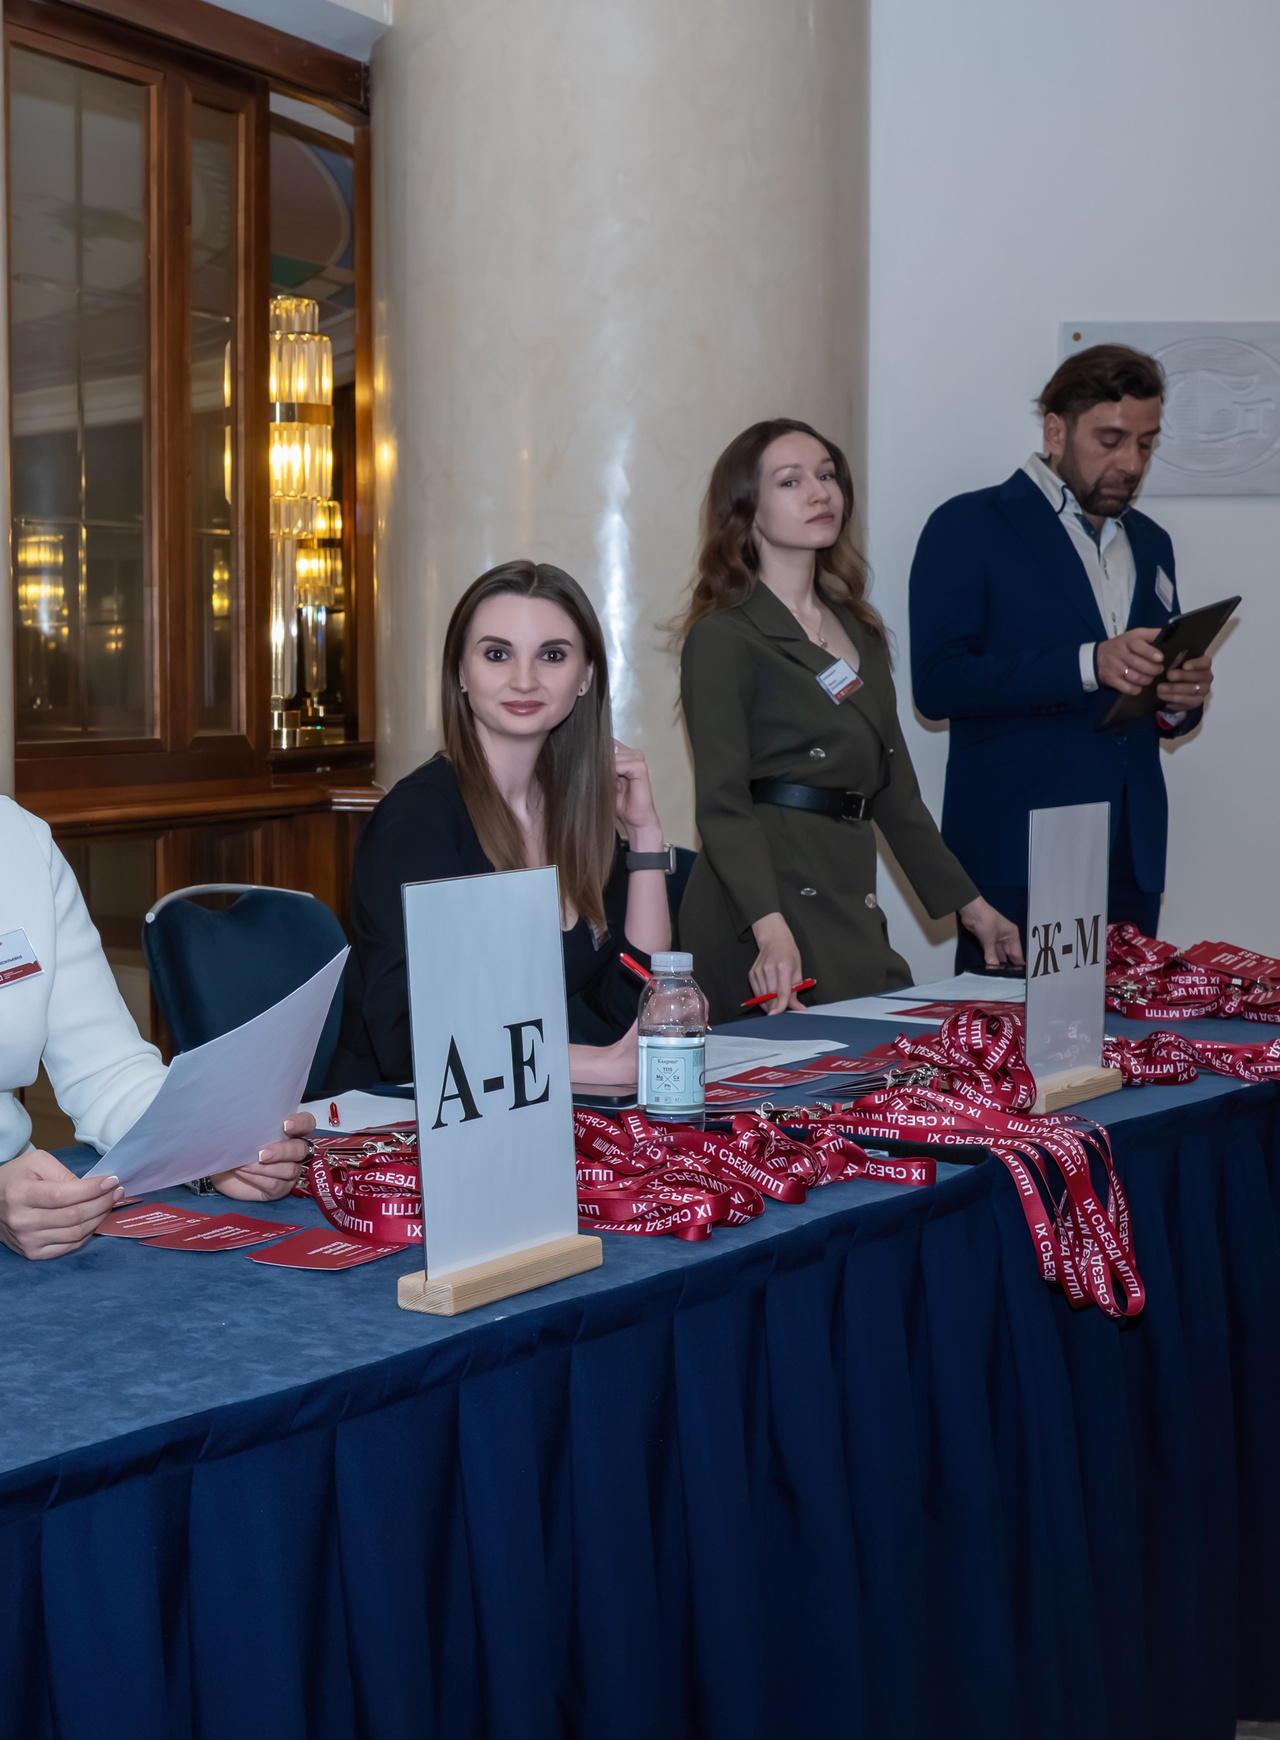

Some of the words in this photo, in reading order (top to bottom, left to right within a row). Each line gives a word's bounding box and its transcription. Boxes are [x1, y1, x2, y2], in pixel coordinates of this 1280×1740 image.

[1031, 914, 1102, 978] Ж-М
[1145, 1008, 1180, 1018] МТПП
[983, 1037, 1010, 1071] МТПП
[431, 1018, 550, 1130] А-Е
[915, 1088, 965, 1112] СЪЕЗД
[887, 1112, 938, 1126] СЪЕЗД
[941, 1116, 955, 1126] IX
[966, 1106, 982, 1119] IX
[605, 1125, 621, 1136] IX
[858, 1126, 900, 1140] МТПП
[927, 1133, 942, 1144] IX
[944, 1134, 995, 1146] СЪЕЗД
[998, 1138, 1040, 1160] МТПП
[703, 1141, 717, 1156] IX
[719, 1148, 753, 1178] СЪЕЗД
[750, 1168, 785, 1195] МТПП
[843, 1162, 859, 1177] IX
[1044, 1141, 1077, 1177] МТПП
[364, 1172, 417, 1190] СЪЕЗД
[911, 1168, 926, 1181] IX
[1005, 1155, 1034, 1196] МТПП
[645, 1208, 692, 1232] СЪЕЗД
[694, 1203, 713, 1219] IX
[342, 1213, 373, 1234] МТПП
[1034, 1222, 1048, 1239] IX
[1083, 1197, 1098, 1214] IX
[1091, 1214, 1122, 1260] СЪЕЗД
[1115, 1259, 1141, 1297] МТПП
[1063, 1261, 1085, 1299] МТПП
[1091, 1254, 1110, 1305] СЪЕЗД
